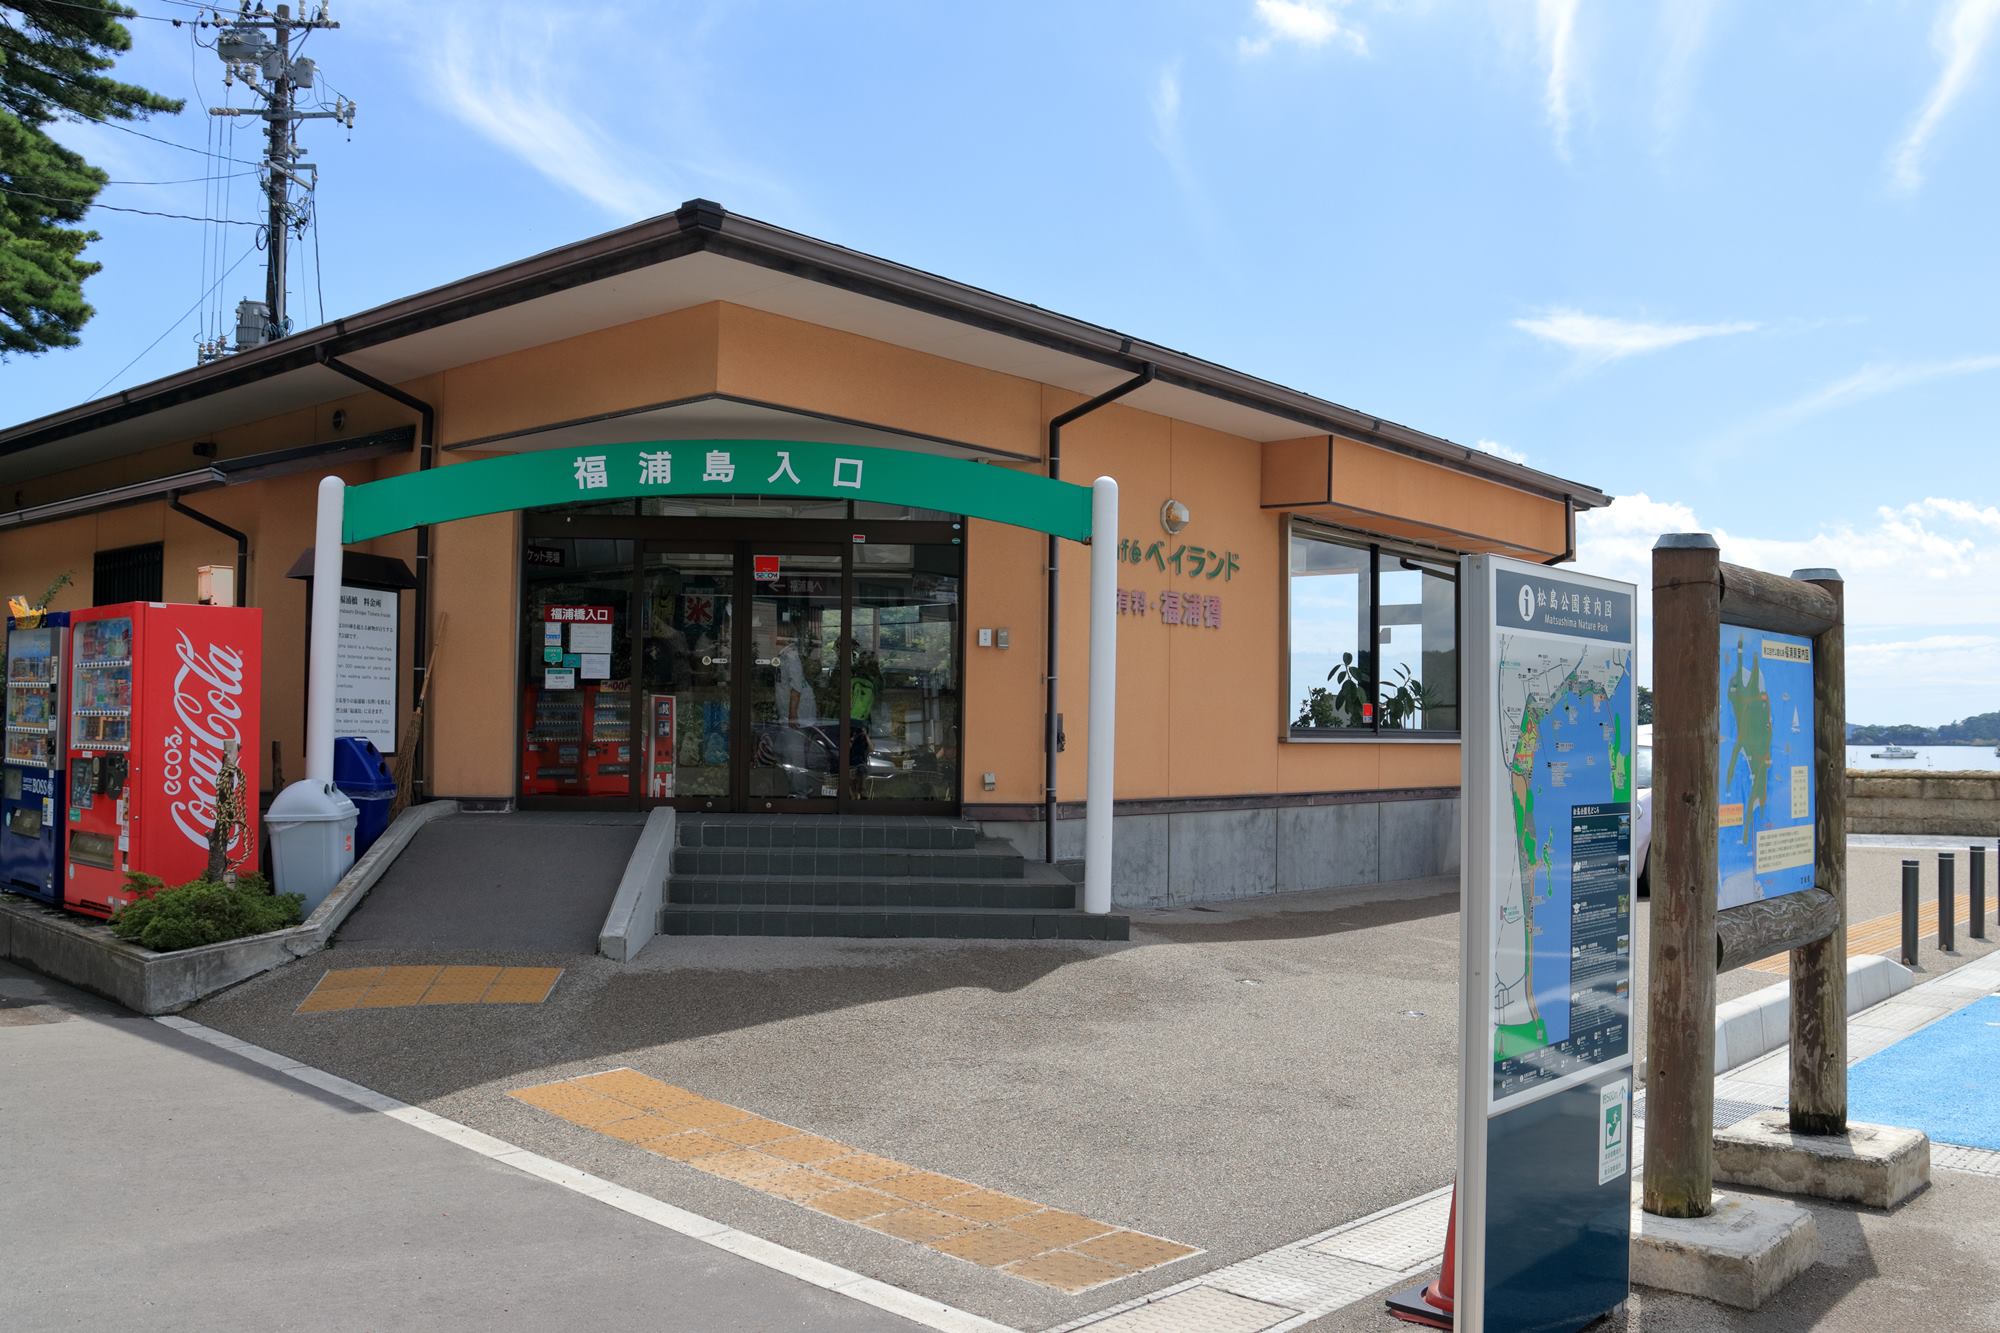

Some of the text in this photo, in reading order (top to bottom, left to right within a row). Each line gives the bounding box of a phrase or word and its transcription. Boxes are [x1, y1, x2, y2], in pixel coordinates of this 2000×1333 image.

[574, 449, 864, 490] 福浦島入口
[686, 596, 713, 623] 氷
[1536, 586, 1612, 619] 松島公園案内図
[550, 607, 608, 622] 福浦橋入口
[1544, 613, 1609, 633] Matsushima Nature Park
[32, 778, 47, 795] BOSS
